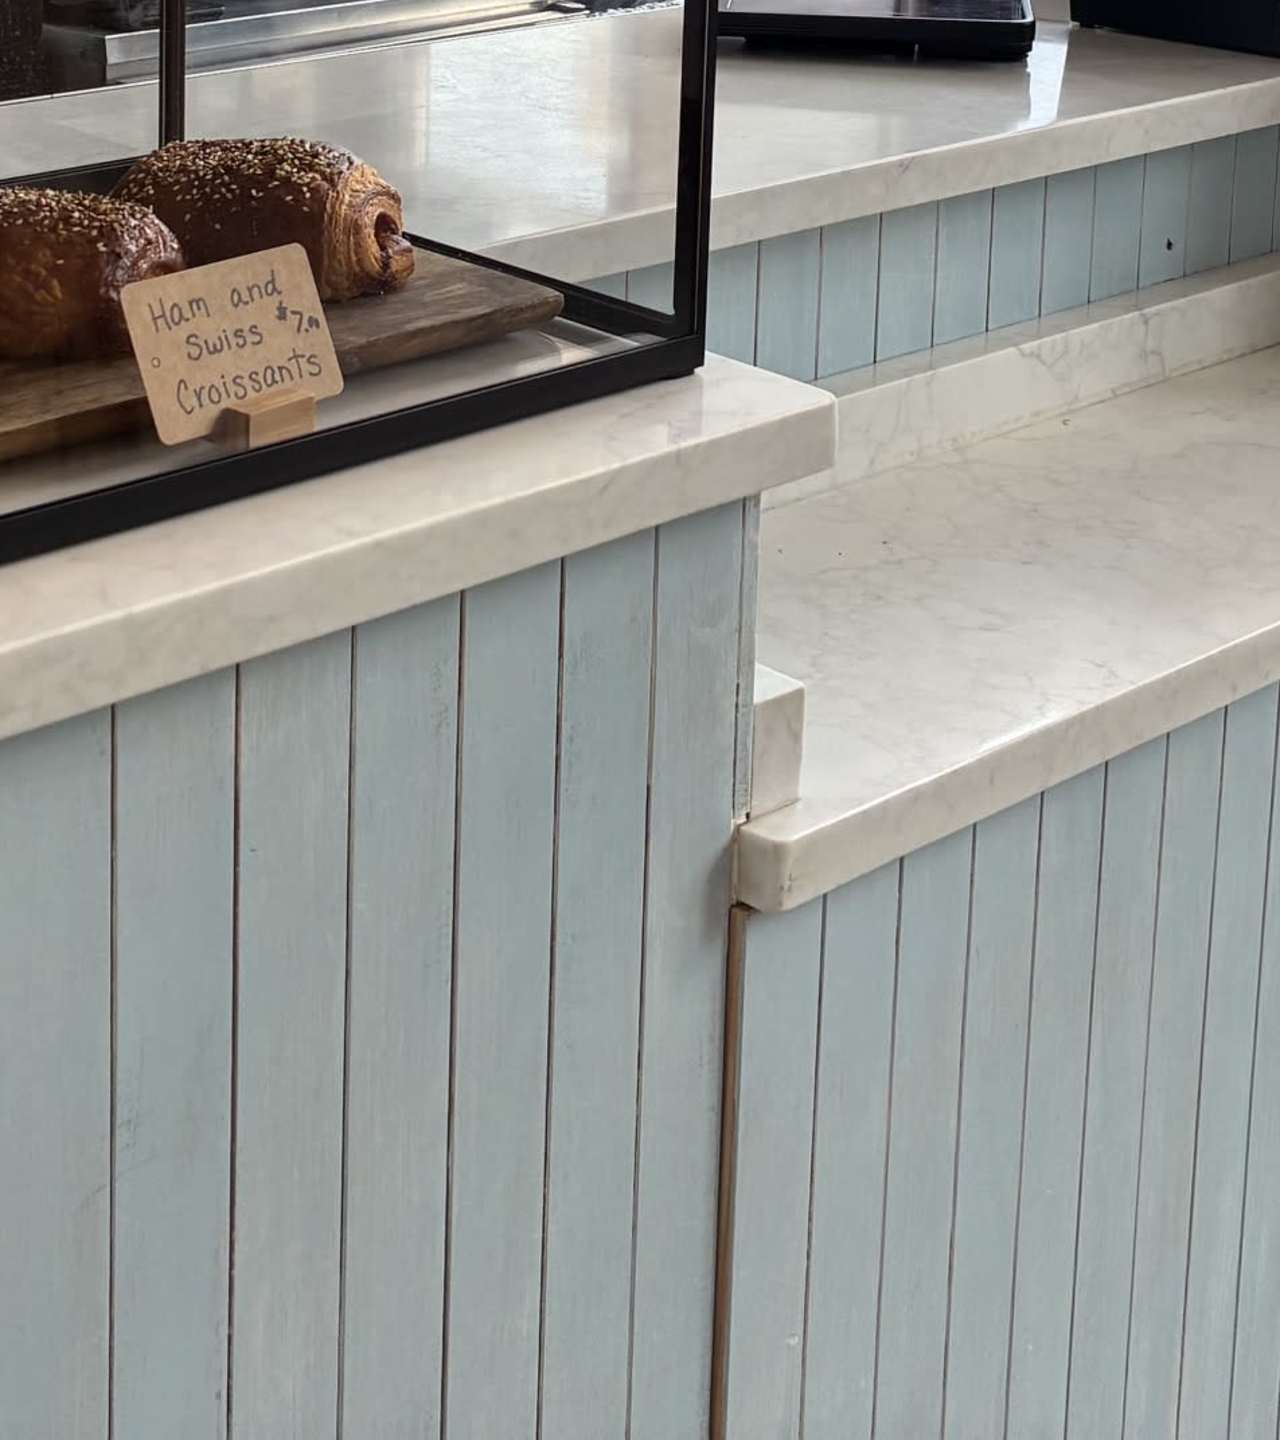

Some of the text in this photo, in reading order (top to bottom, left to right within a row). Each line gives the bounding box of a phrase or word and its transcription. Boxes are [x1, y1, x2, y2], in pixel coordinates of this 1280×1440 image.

[147, 268, 283, 334] Ham and
[185, 323, 265, 362] Swiss
[175, 347, 323, 416] Croissants
